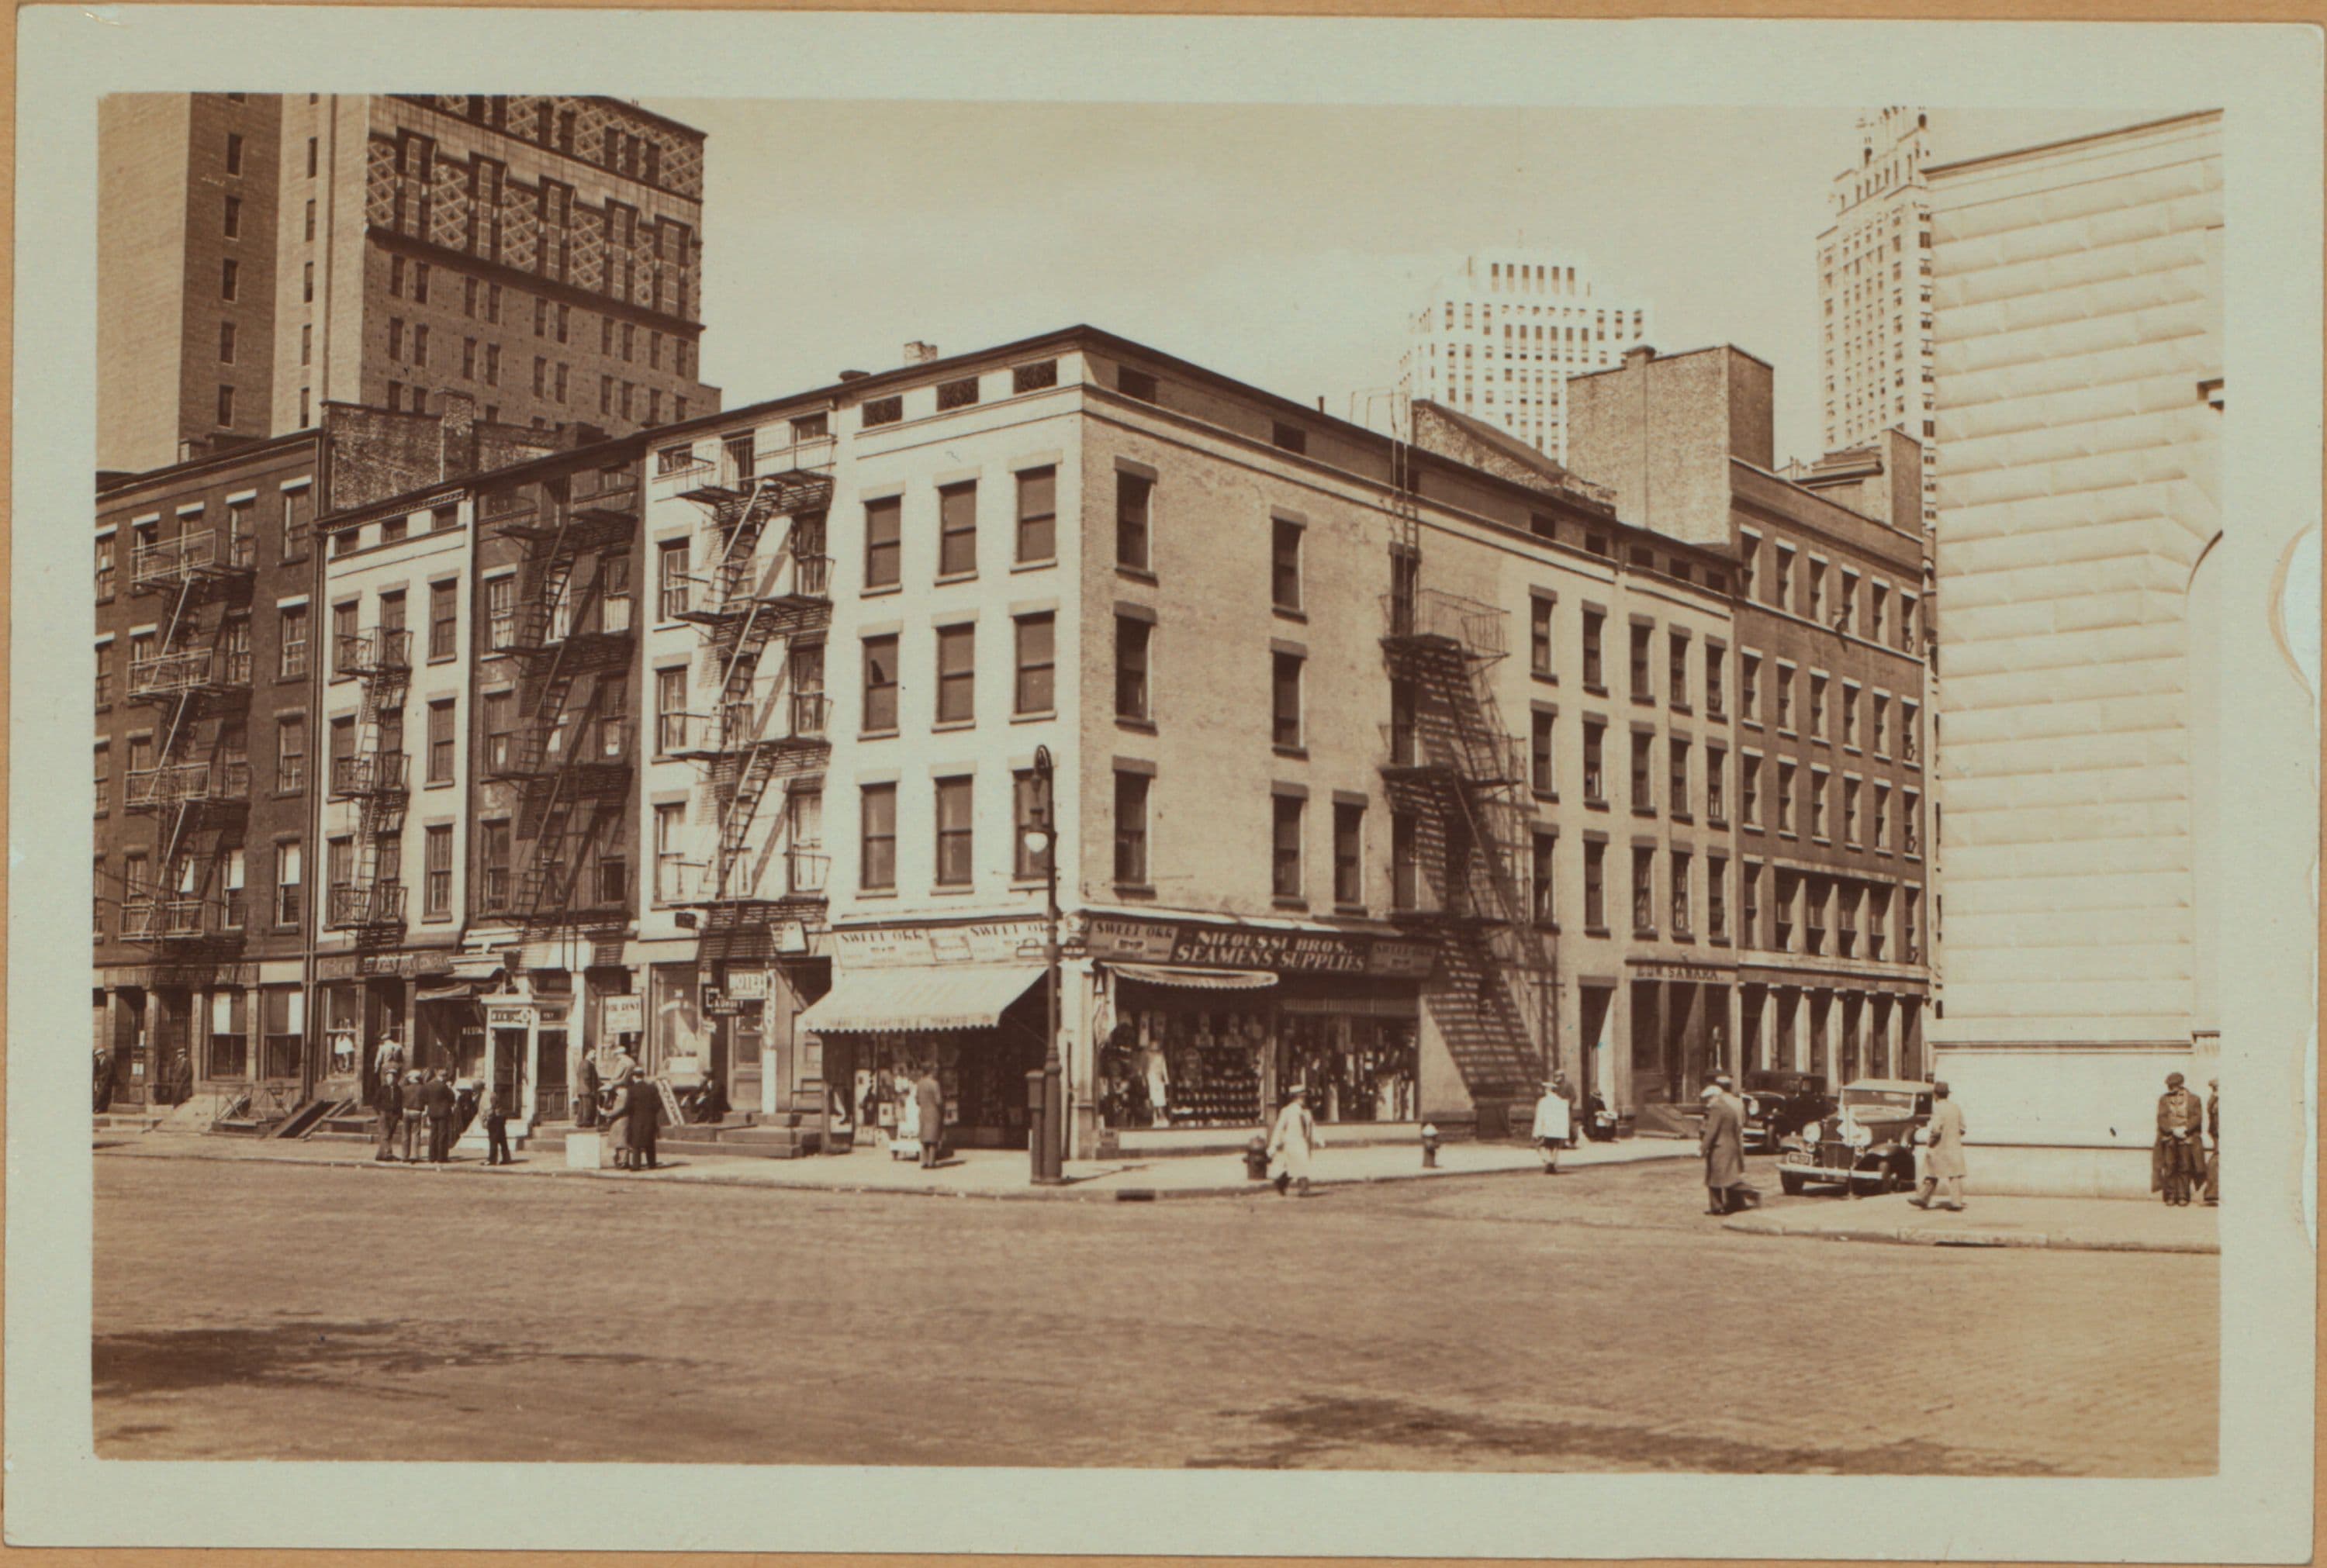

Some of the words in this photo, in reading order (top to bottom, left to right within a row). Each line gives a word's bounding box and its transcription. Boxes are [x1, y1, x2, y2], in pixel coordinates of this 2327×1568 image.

[969, 924, 1018, 936] SWEET
[1096, 922, 1140, 937] SWEET
[841, 932, 886, 943] SWEET
[1175, 944, 1274, 966] SEAMENS
[1278, 950, 1365, 972] SUPPLIES
